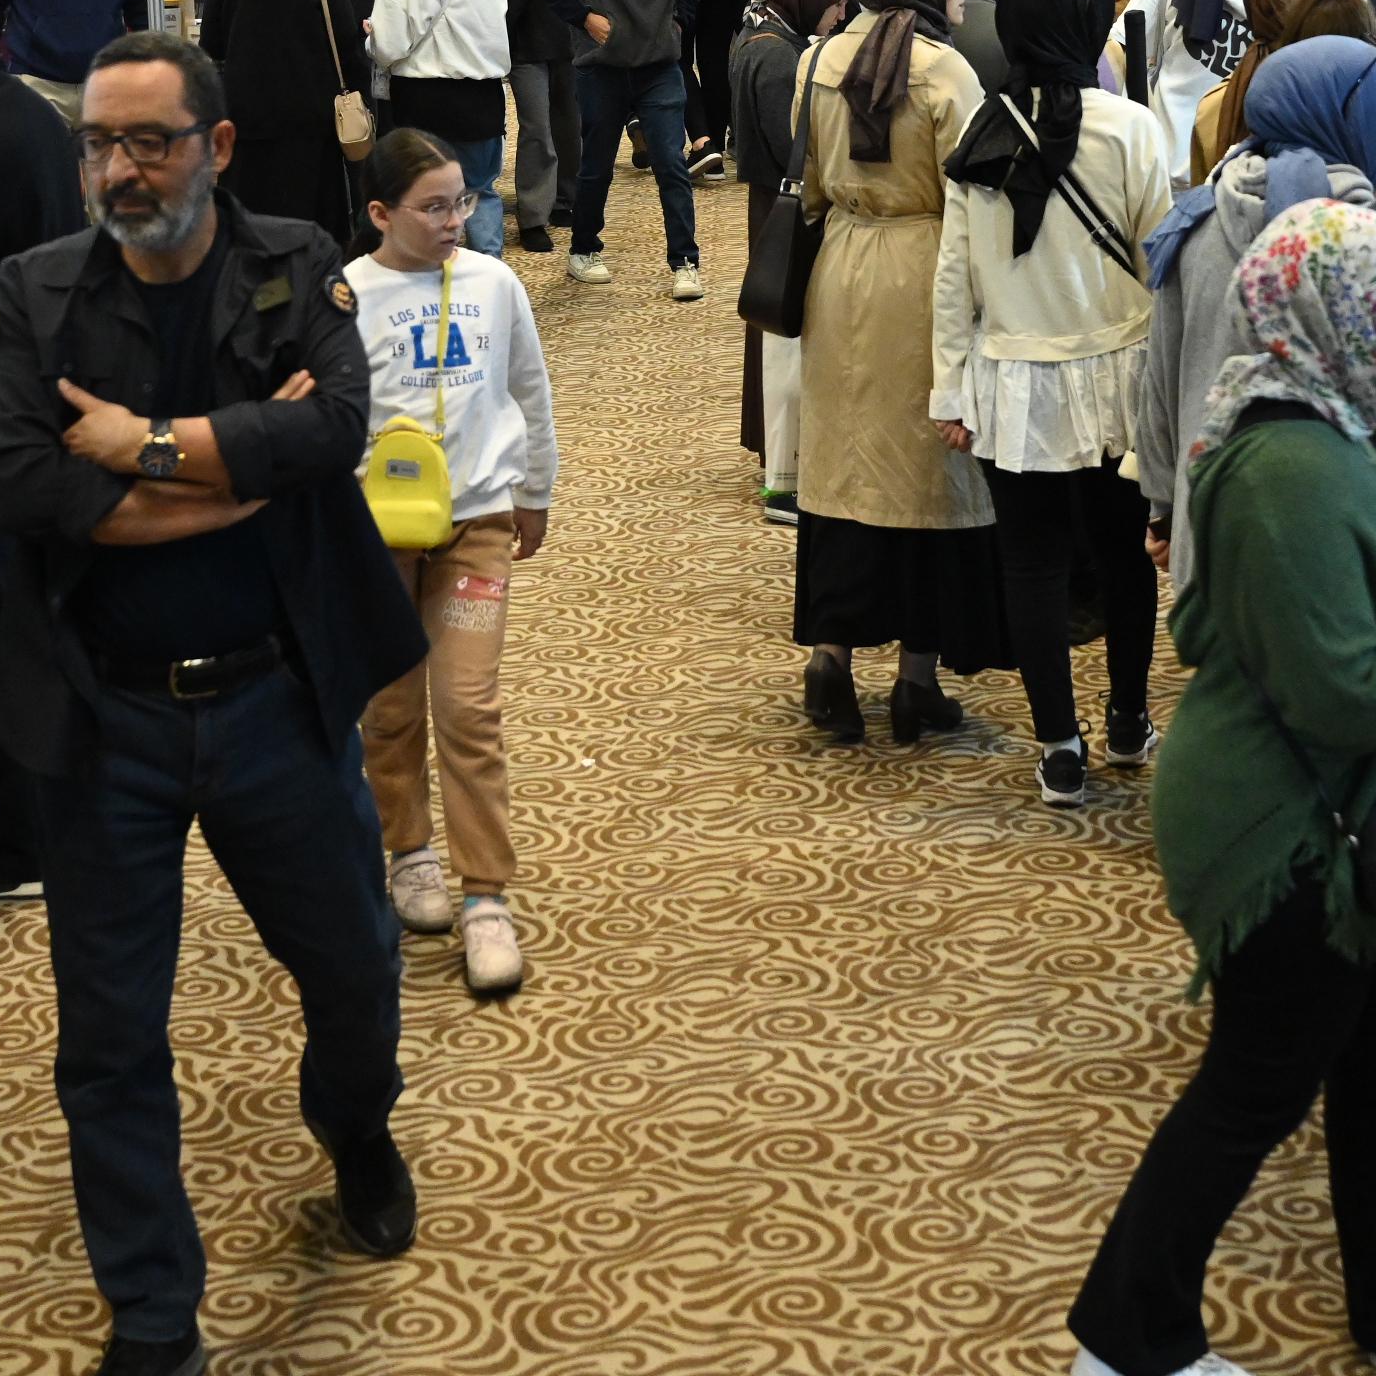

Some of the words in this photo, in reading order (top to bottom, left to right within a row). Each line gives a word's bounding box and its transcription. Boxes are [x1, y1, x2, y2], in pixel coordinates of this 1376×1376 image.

[389, 308, 416, 327] LOS
[422, 303, 481, 318] ANELES
[391, 342, 405, 358] 19
[410, 322, 472, 369] LA
[476, 335, 490, 349] 72
[448, 370, 485, 388] LEAGUE
